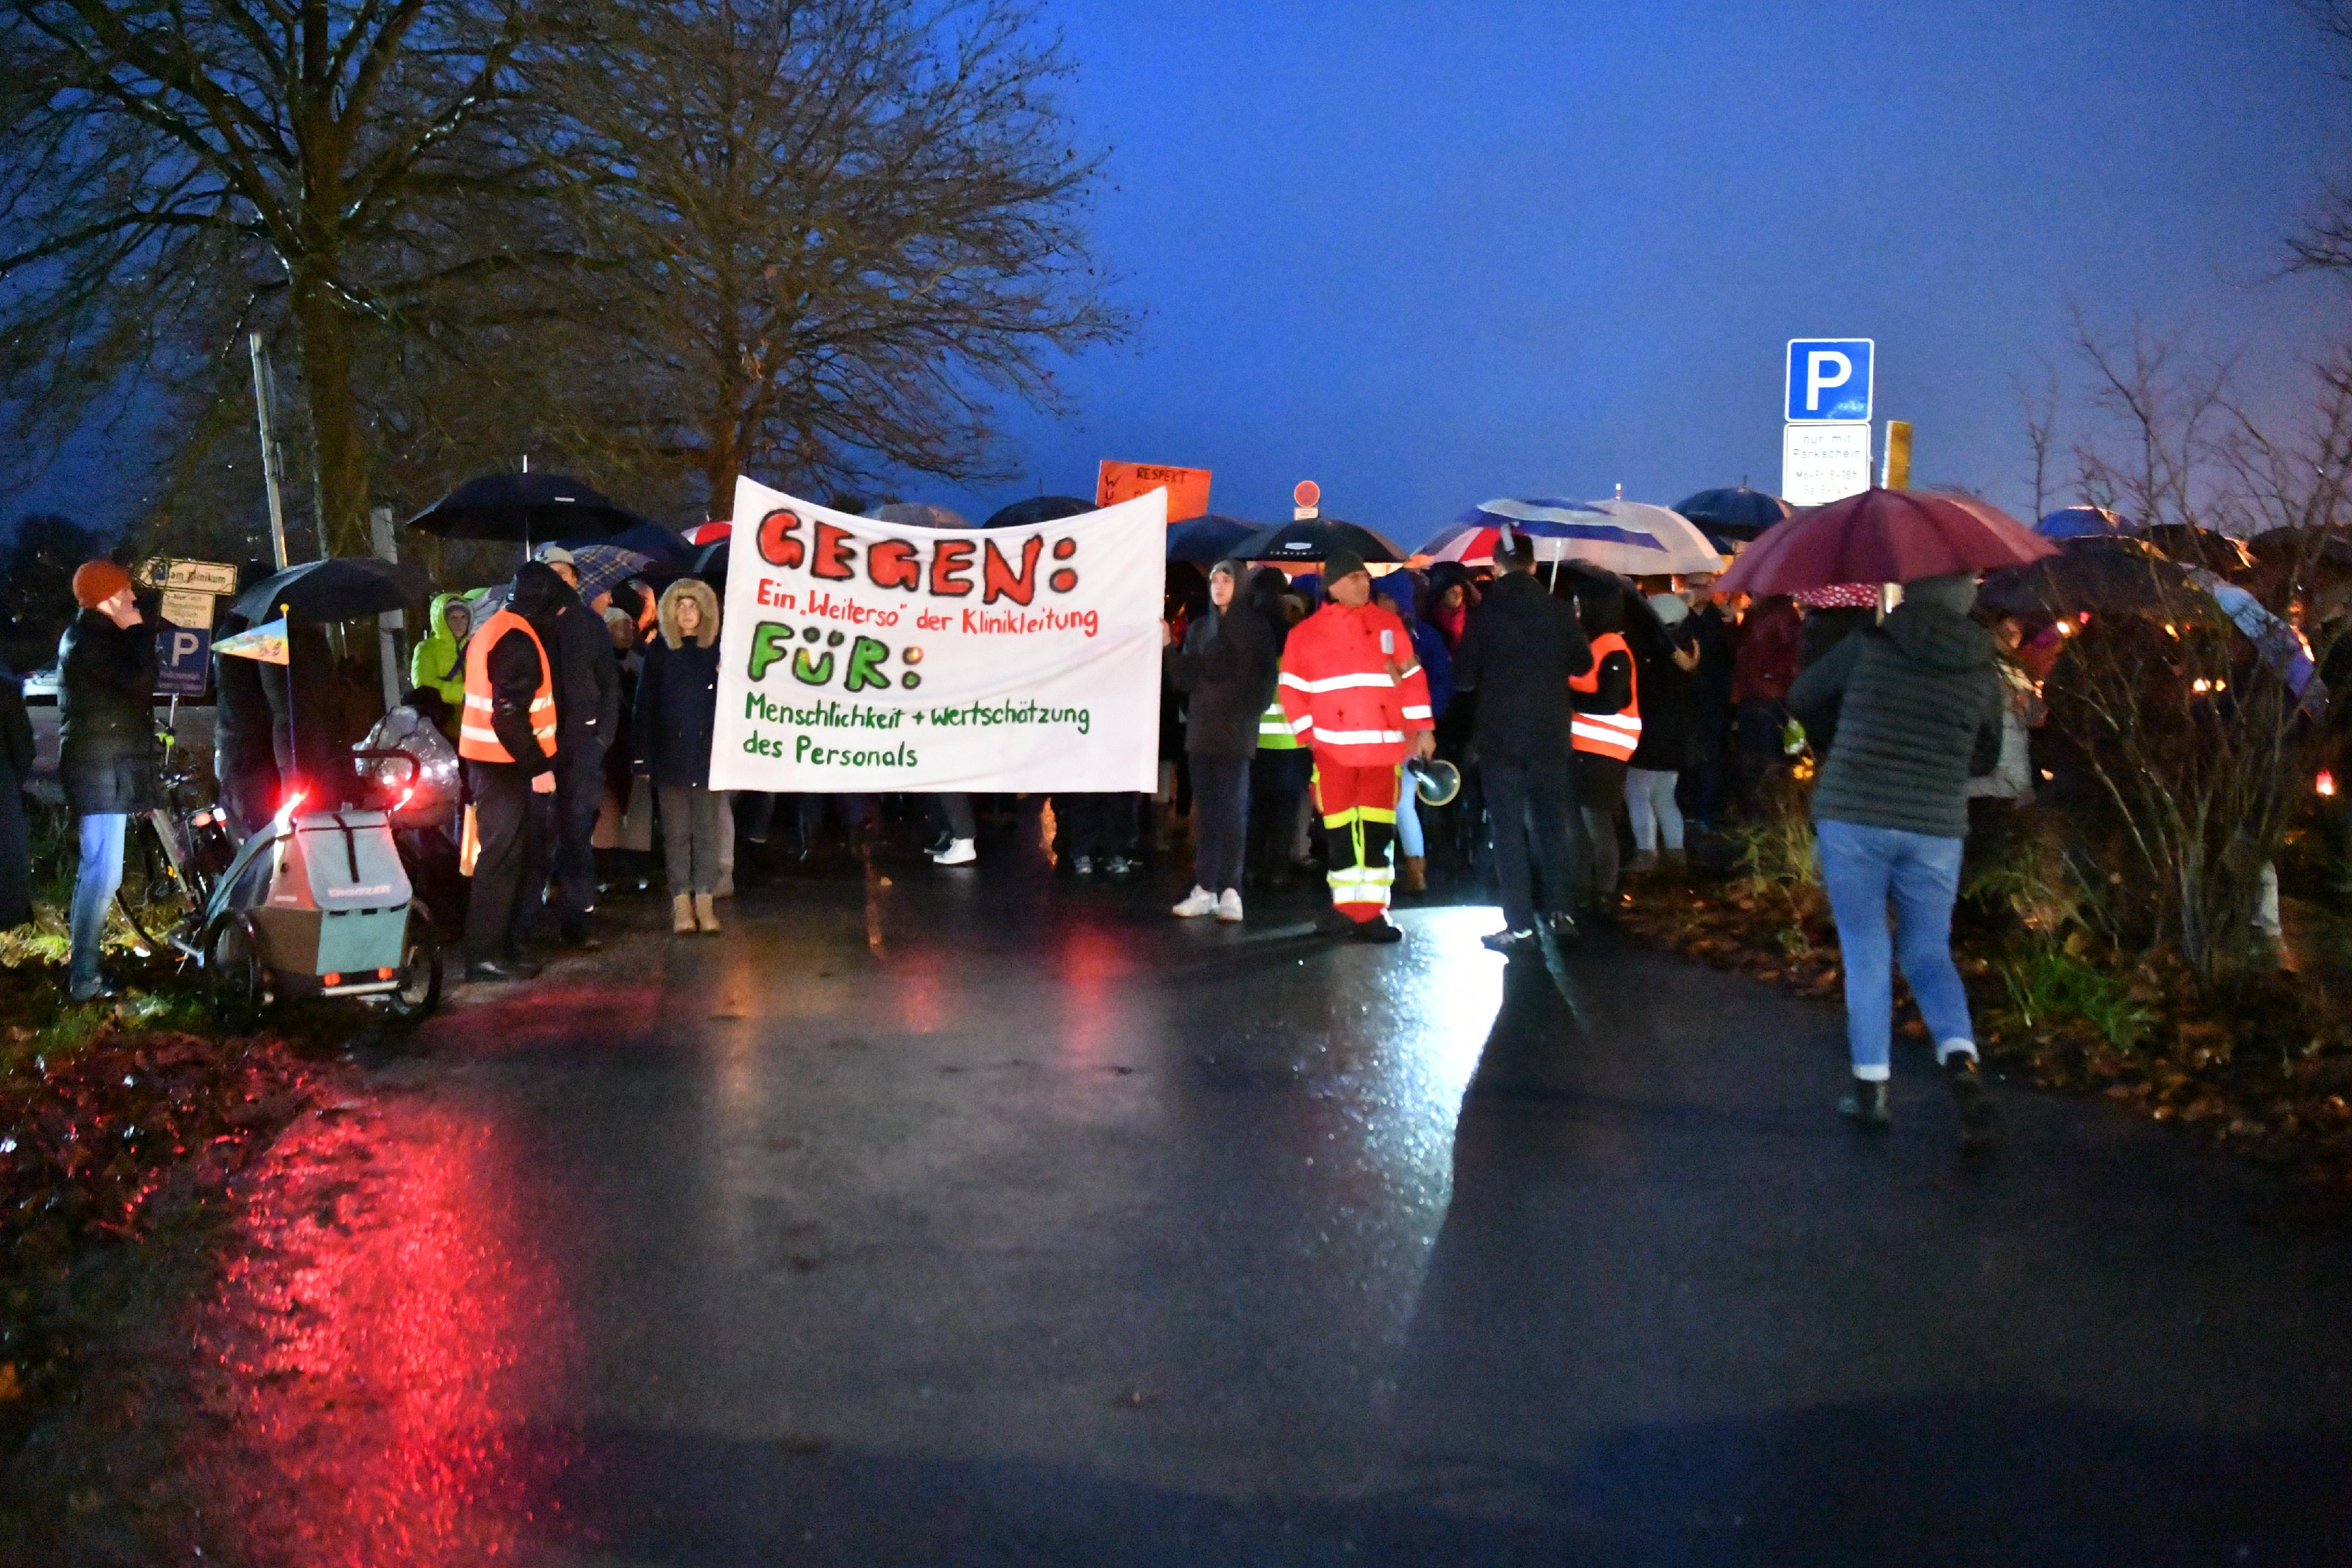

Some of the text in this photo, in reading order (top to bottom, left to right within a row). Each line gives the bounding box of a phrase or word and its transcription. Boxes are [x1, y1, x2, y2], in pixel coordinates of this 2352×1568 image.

[1806, 351, 1852, 411] P
[1793, 448, 1861, 458] Parkschein
[1803, 434, 1851, 444] nur mit
[1137, 467, 1189, 484] RESPEKT
[756, 508, 1078, 605] GEGEN:
[757, 578, 795, 610] Ein
[916, 607, 952, 631] der
[962, 607, 1098, 637] Klinikleitung
[171, 632, 200, 667] P
[747, 620, 925, 692] FÜR:
[744, 691, 902, 728] Menschlichkeit
[911, 712, 925, 725] +
[743, 730, 918, 767] des Personals
